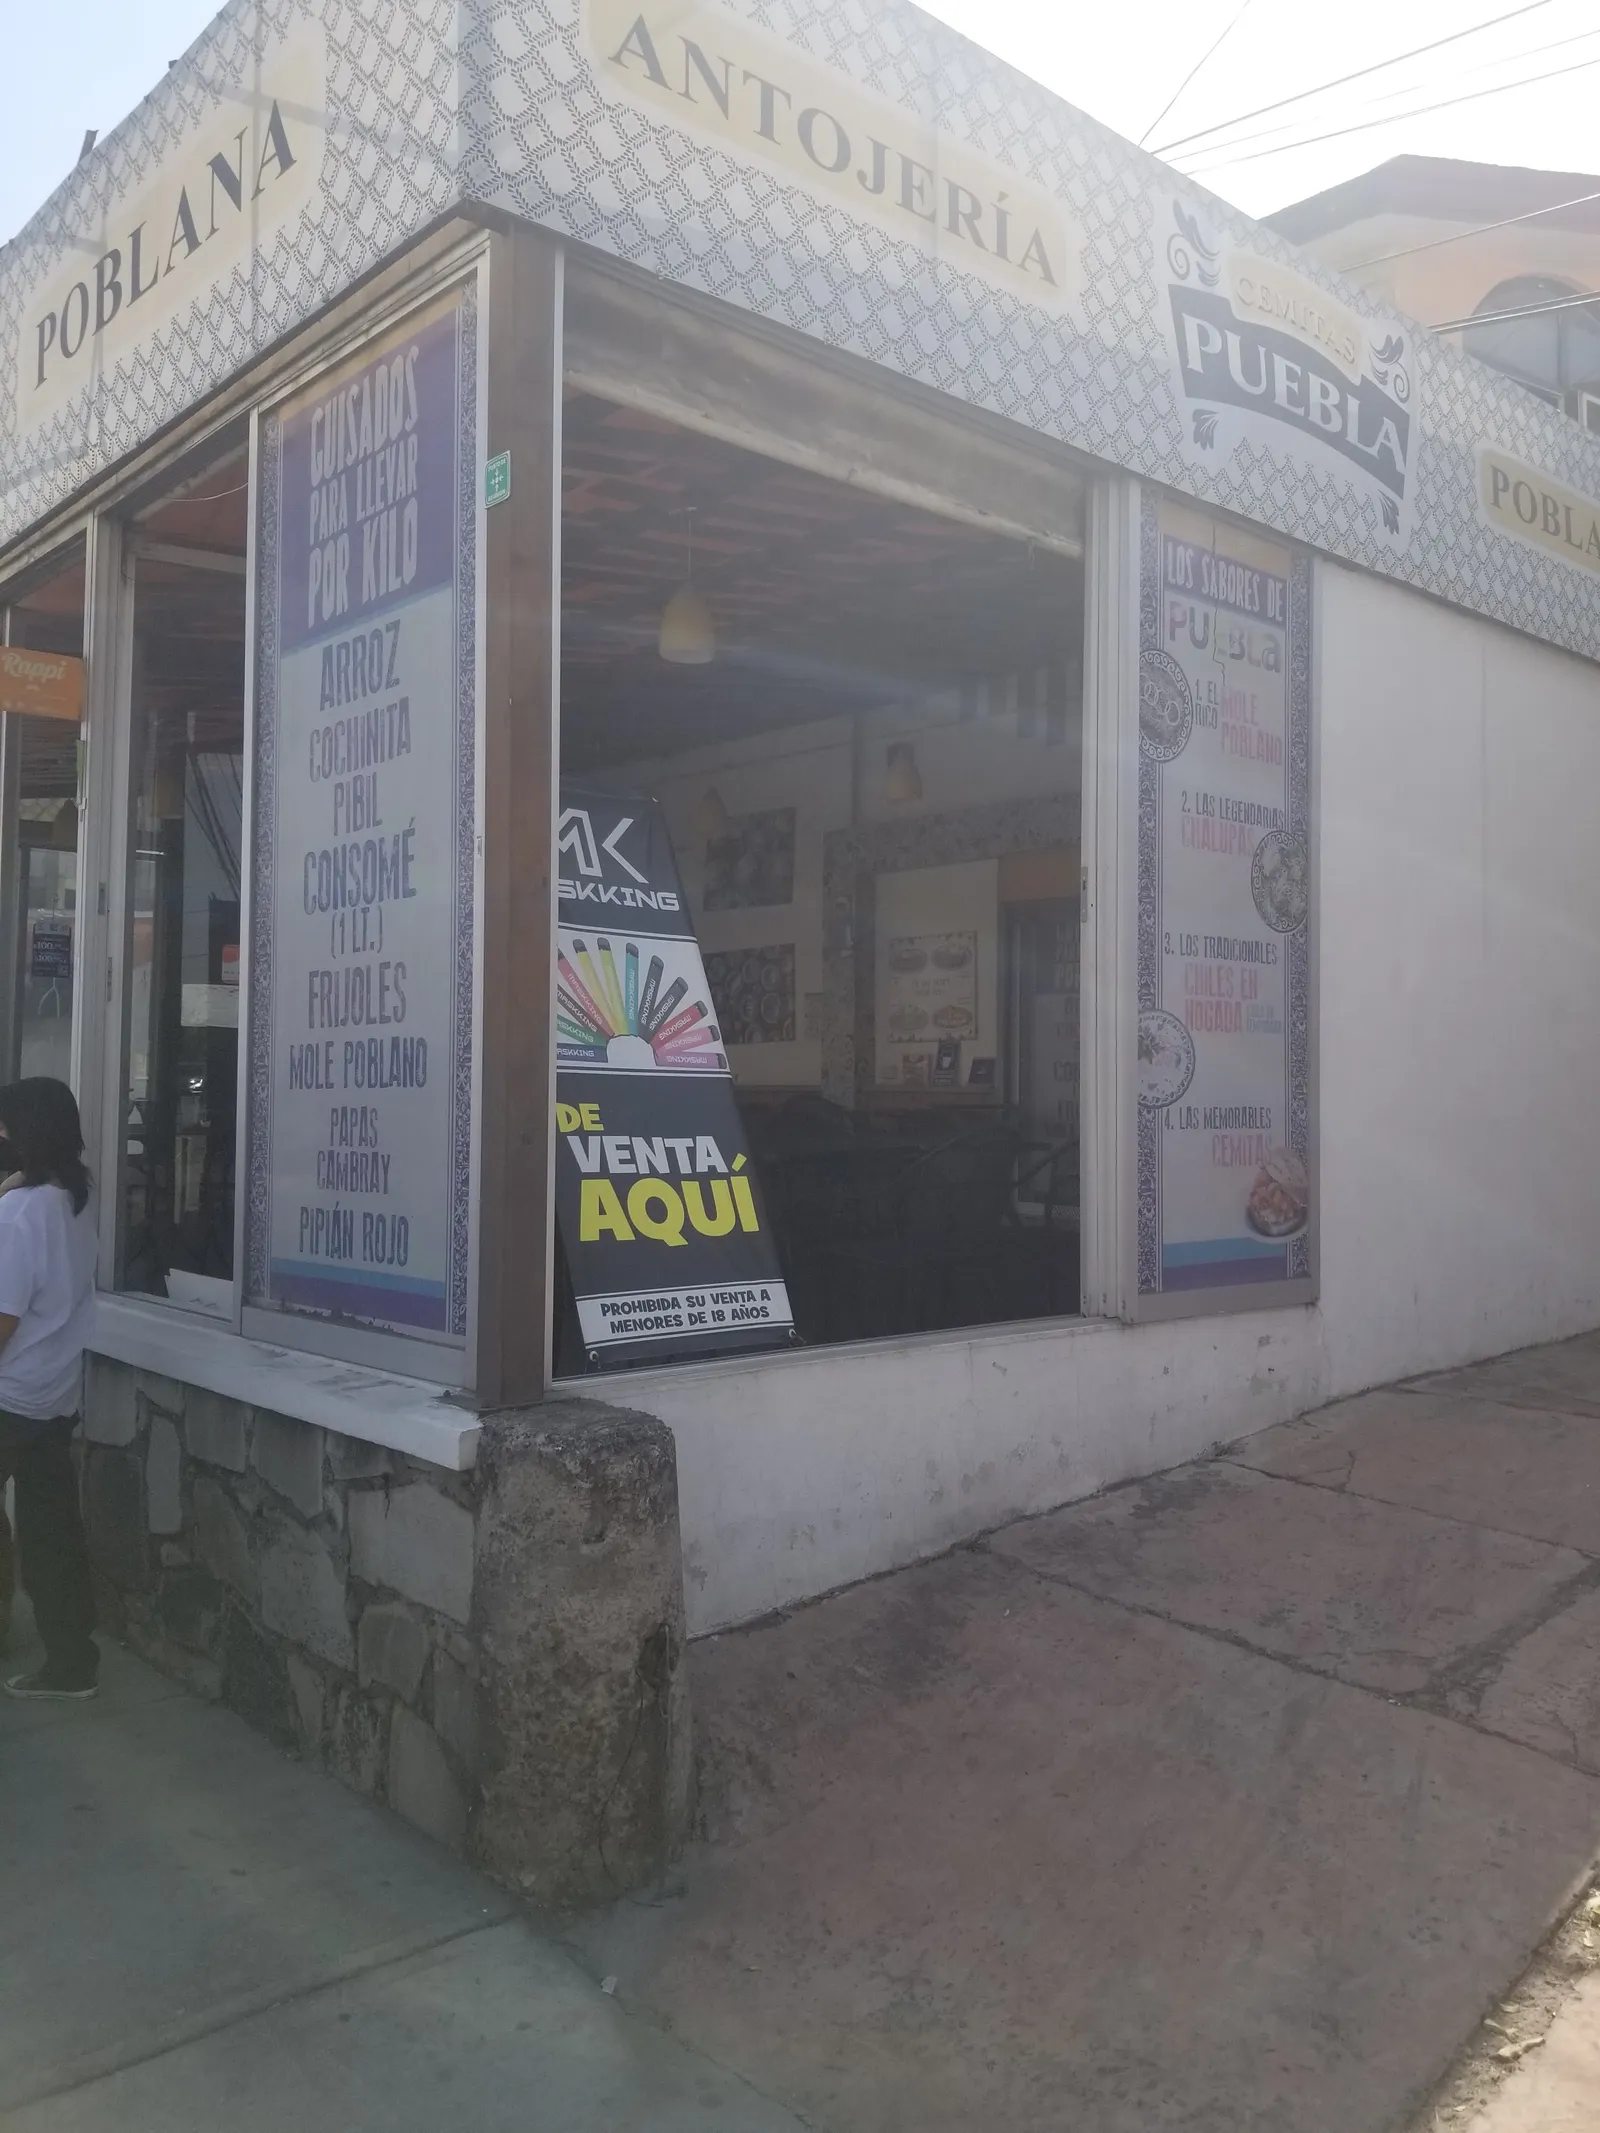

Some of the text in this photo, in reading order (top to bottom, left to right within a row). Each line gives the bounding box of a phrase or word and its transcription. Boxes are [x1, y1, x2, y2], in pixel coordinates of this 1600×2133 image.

[607, 13, 1059, 288] ANTOJERÍA
[34, 99, 297, 390] POBLANA
[311, 346, 419, 487] GUISADOS
[1182, 313, 1406, 473] PUEBLA
[310, 434, 418, 547] PARA LLEVAR
[308, 497, 418, 629] POR KILO
[1168, 542, 1283, 621] LOS SABORES DE
[3, 652, 67, 683] Rappi
[320, 619, 400, 711] ARROZ
[1195, 679, 1218, 706] 1. EL
[1221, 687, 1259, 727] MOLE
[309, 696, 411, 782] COCHINITA
[1221, 722, 1283, 765] POBLANO
[333, 772, 383, 836] PIBIL
[1182, 791, 1284, 831] 2. LAS LEGENDARIAS
[304, 817, 417, 915] CONSOMÉ
[352, 905, 383, 954] LT.)
[1164, 932, 1278, 965] 3. LOS TRADICIONALES
[309, 961, 407, 1029] FRIJOLES
[1185, 962, 1258, 1000] CHILES EN
[289, 1036, 428, 1090] MOLE POBLANO
[330, 1105, 378, 1148] PAPAS
[556, 1103, 604, 1132] DE
[1164, 1106, 1272, 1130] 4. LAS MEMORABLES
[317, 1150, 391, 1194] CAMBRAY
[567, 1136, 729, 1174] VENTA
[1212, 1134, 1272, 1167] CEMITAS
[580, 1153, 760, 1247] AQUÍ
[300, 1201, 410, 1267] PIPIÁN ROJO
[601, 1288, 772, 1317] PROHIBIDA SU VENTA A
[610, 1304, 770, 1334] MENORES DE 18 AÑOS
